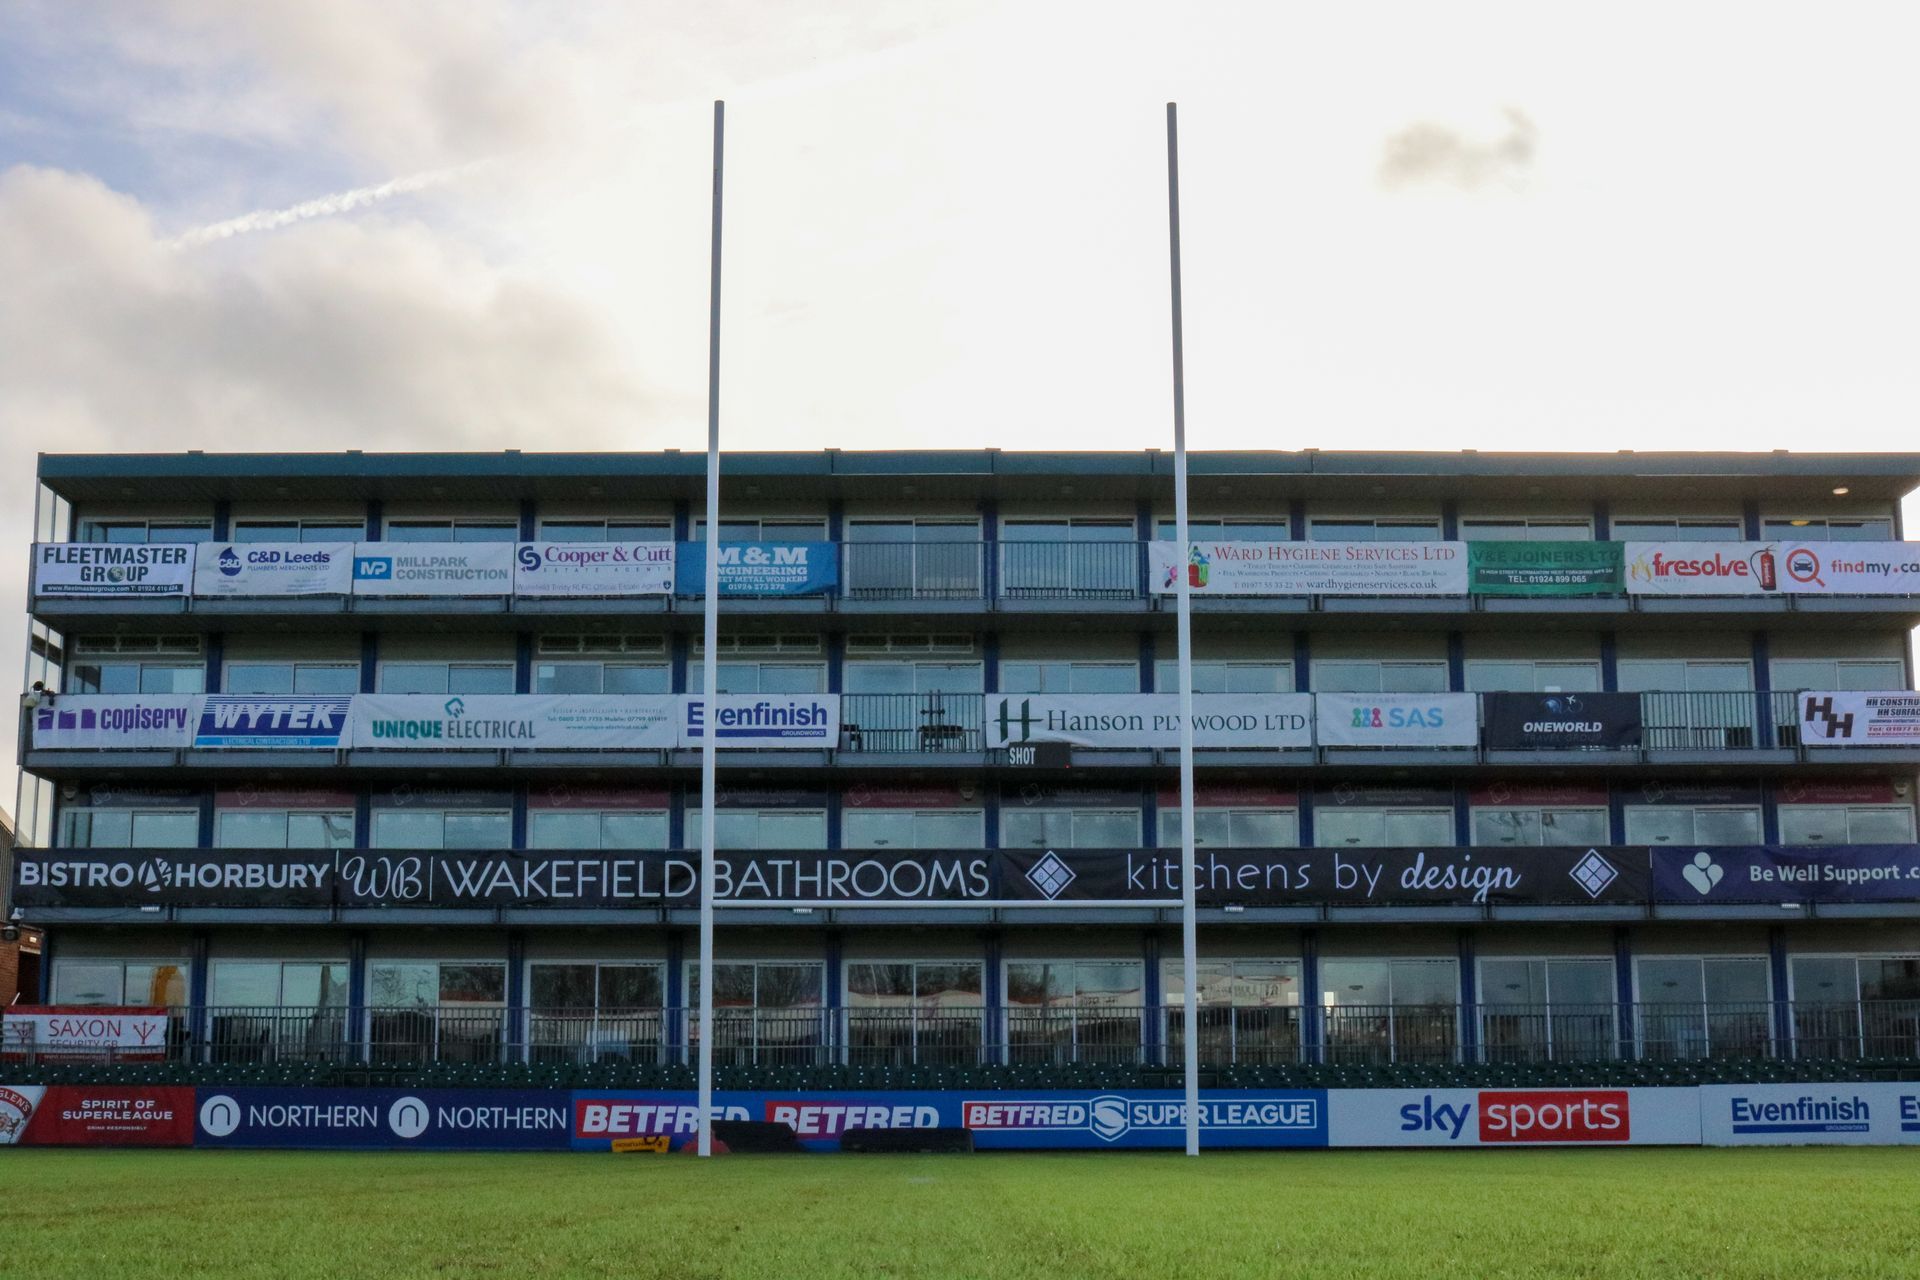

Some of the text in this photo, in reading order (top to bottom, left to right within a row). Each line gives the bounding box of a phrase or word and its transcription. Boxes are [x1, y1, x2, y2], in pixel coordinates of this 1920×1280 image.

[43, 547, 188, 564] FLEETMASTER
[247, 551, 331, 563] C&D Leeds
[397, 557, 468, 568] MILLPARK
[545, 546, 609, 567] Cooper
[613, 546, 628, 562] &
[1215, 546, 1456, 561] WARD HYGIENE SERVICES LTD
[1512, 550, 1586, 562] JOINERS
[1590, 550, 1620, 562] LTD
[1653, 552, 1748, 576] firesolve
[80, 566, 149, 582] GROUP
[396, 569, 508, 580] CONSTRUCTION
[718, 567, 808, 575] NGINEERING
[1306, 579, 1438, 590] wardhygieneservices.co.uk
[100, 704, 188, 733] copiserv
[214, 704, 338, 729] WYTEK
[687, 702, 828, 726] Eenfinish
[1048, 709, 1144, 731] Hanson
[1264, 714, 1306, 730] LTD
[1388, 707, 1444, 728] SAS
[372, 720, 537, 740] UNIQUE ELECTRICAL
[1523, 721, 1602, 732] ONEWORLD
[1009, 747, 1036, 765] SHOT
[20, 862, 134, 887] BISTRO
[175, 863, 330, 888] HORBURY
[441, 860, 697, 898] WAKEFIELD
[712, 860, 990, 897] BATHROOMS
[1335, 852, 1383, 898] by
[1400, 851, 1522, 904] design
[1750, 866, 1774, 882] Be
[1776, 865, 1819, 882] Well
[1823, 864, 1900, 885] Support
[49, 1019, 121, 1038] SAXON
[81, 1099, 156, 1109] SPIRIT OF
[968, 1105, 1086, 1125] BETFRED
[1213, 1104, 1311, 1125] LEAGUE
[1731, 1096, 1870, 1122] Evenfinish
[62, 1110, 173, 1121] SUPERLEAGUE
[249, 1105, 378, 1128] NORTHERN
[438, 1107, 567, 1129] NORTHERN
[773, 1105, 940, 1135] BETFRED
[1400, 1094, 1622, 1140] sky sports
